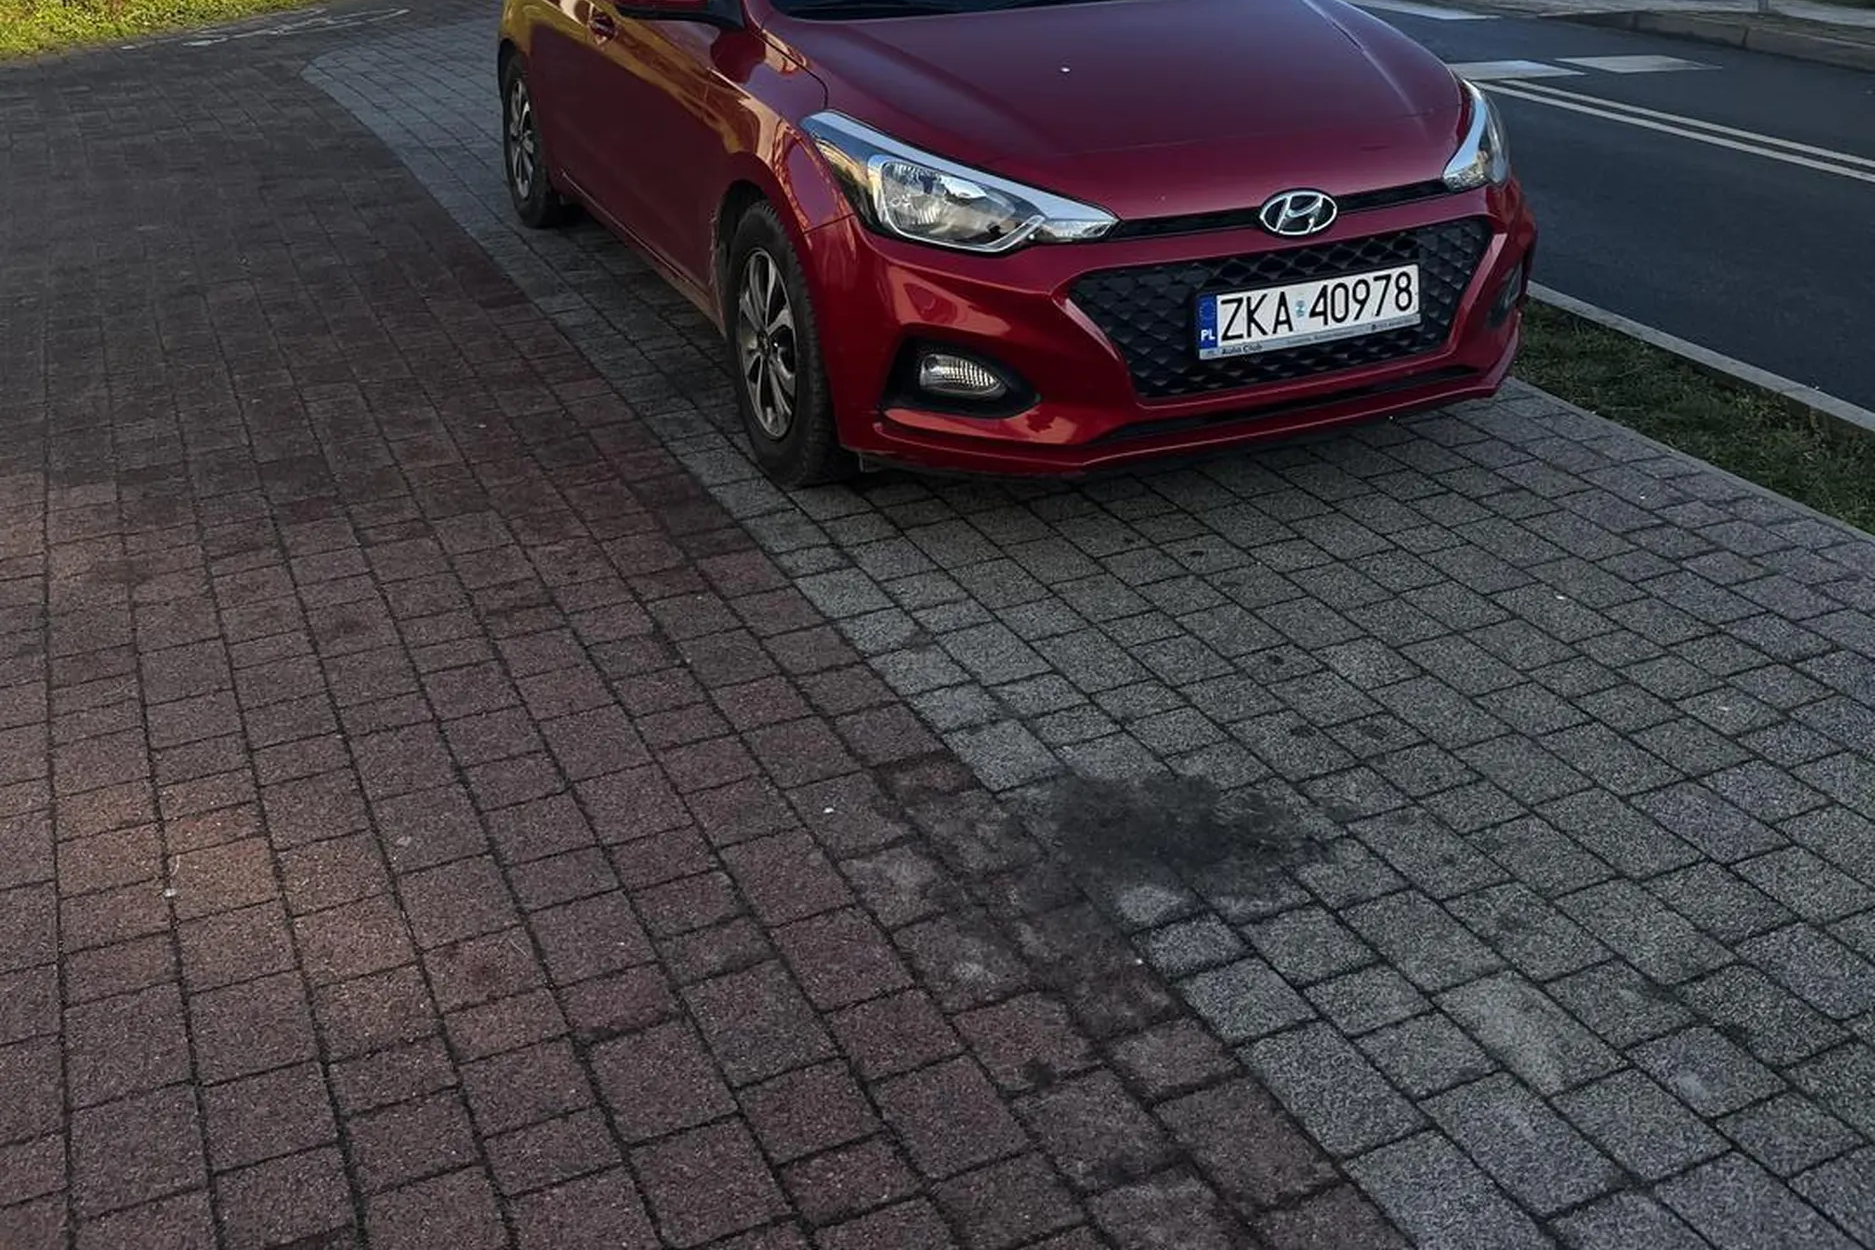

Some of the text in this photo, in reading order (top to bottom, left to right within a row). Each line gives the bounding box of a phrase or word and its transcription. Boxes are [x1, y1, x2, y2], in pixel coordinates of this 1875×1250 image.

[1221, 291, 1293, 342] ZKA
[1309, 271, 1413, 326] 40978
[1201, 329, 1216, 342] PL
